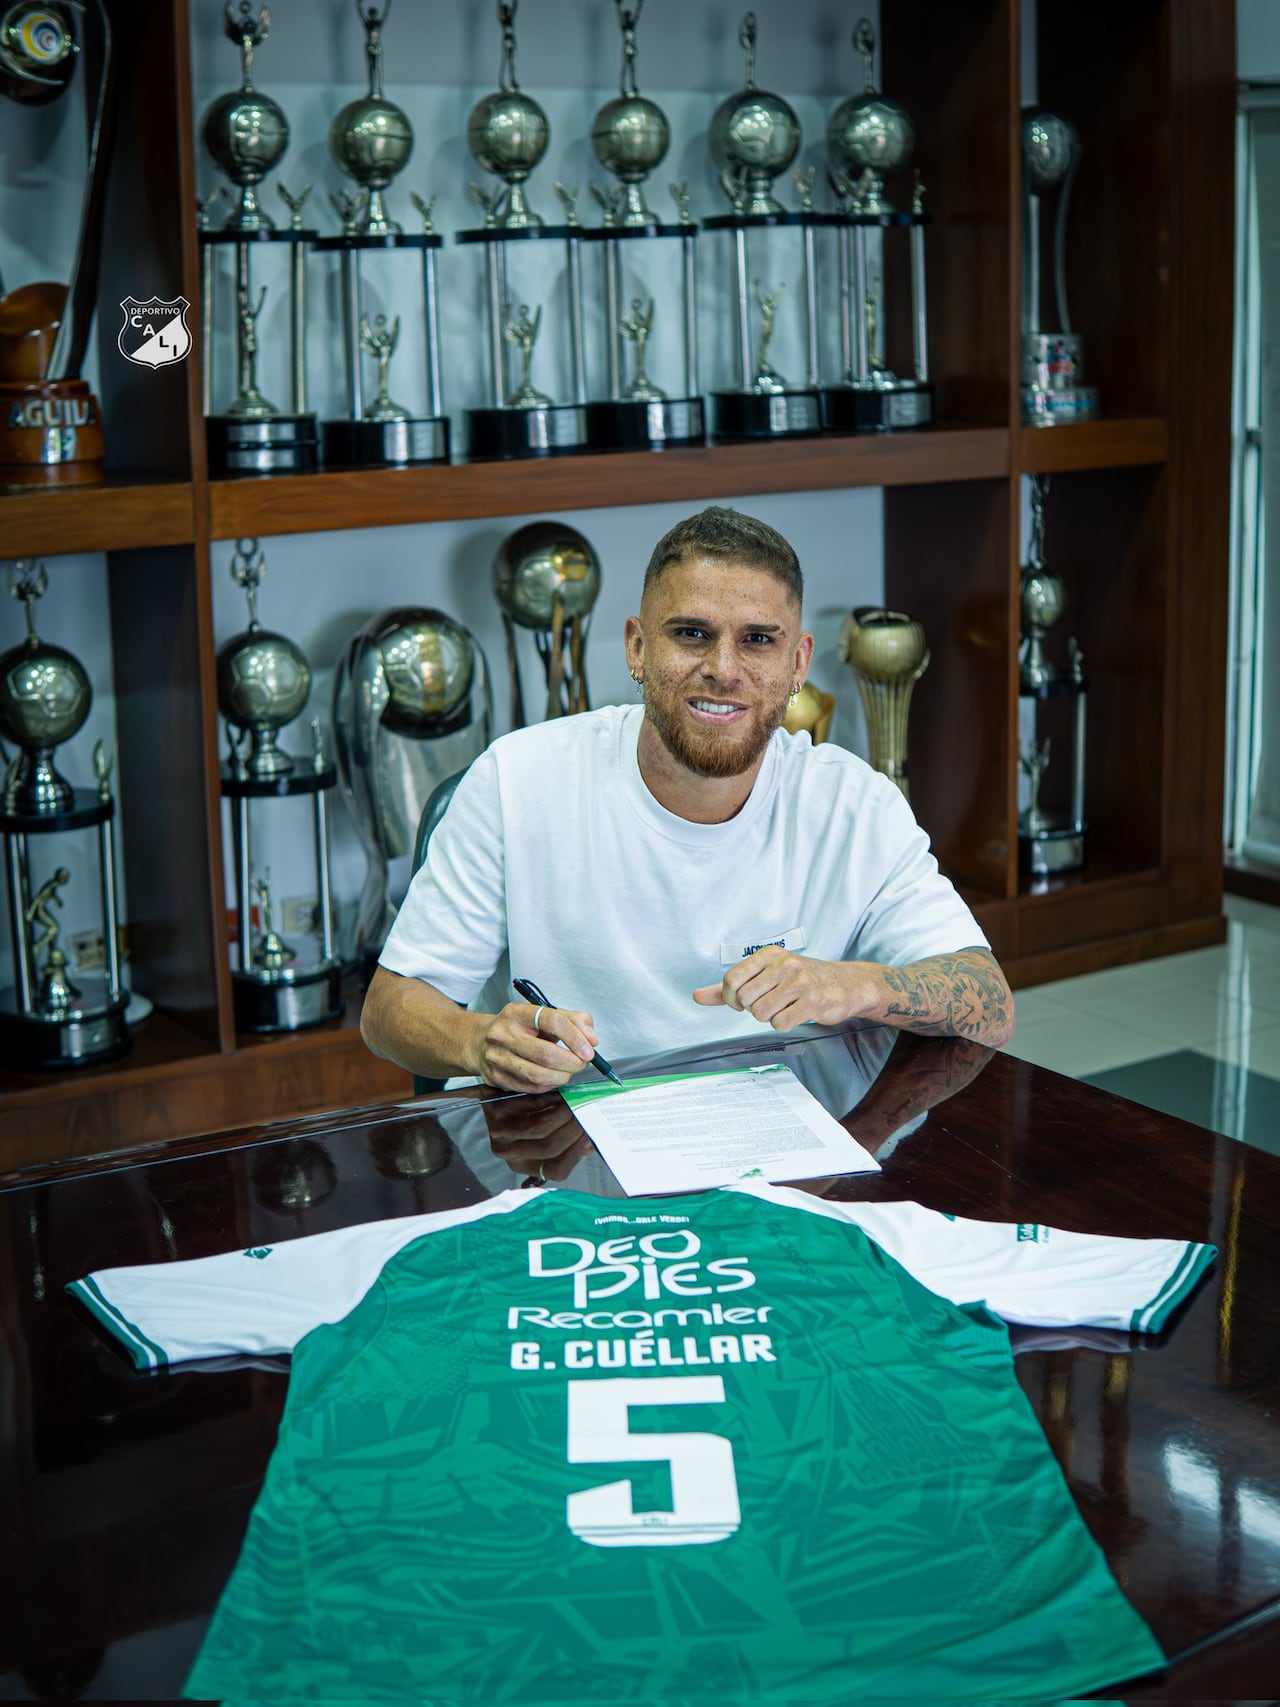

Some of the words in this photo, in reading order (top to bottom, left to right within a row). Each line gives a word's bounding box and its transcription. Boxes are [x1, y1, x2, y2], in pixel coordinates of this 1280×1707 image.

[528, 1229, 701, 1278] DEO
[564, 1329, 776, 1369] CUÉLLAR
[567, 1375, 741, 1547] 5
